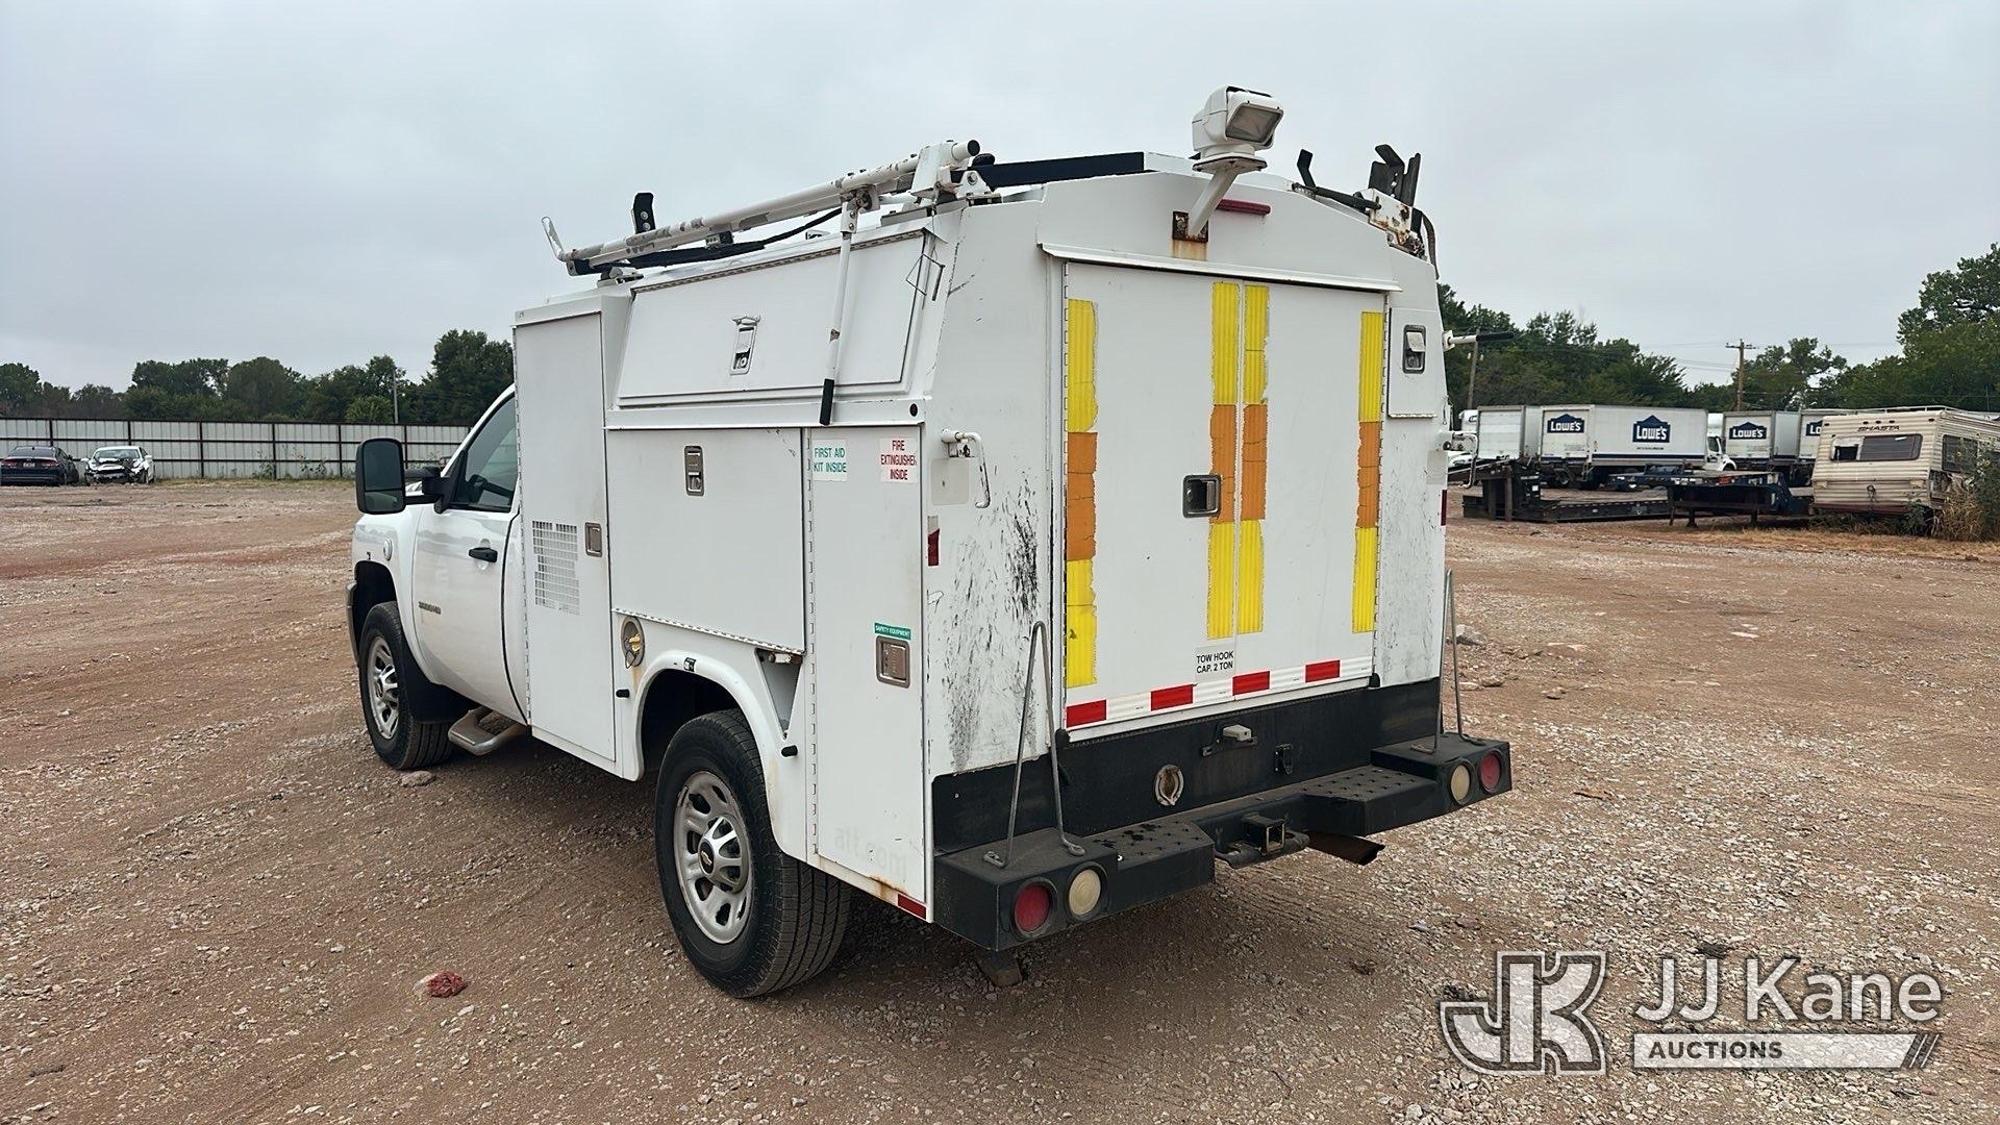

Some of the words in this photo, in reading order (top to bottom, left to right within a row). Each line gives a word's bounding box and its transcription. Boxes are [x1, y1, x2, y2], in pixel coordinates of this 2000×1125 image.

[1550, 421, 1582, 431] LOWE'S
[1636, 425, 1667, 440] LOWE'S
[1732, 428, 1764, 438] LOWE'S
[892, 440, 905, 451] FIRE
[814, 447, 832, 458] FIRST
[834, 447, 845, 458] AID
[880, 454, 918, 466] EXTINGUISHER
[813, 462, 823, 472] KIT
[825, 462, 847, 473] INSIDE
[890, 469, 908, 480] INSIDE
[1196, 654, 1212, 663] TOW
[1213, 650, 1234, 661] HOOK
[1196, 664, 1212, 673] CAP.
[1213, 663, 1218, 672] 2
[1219, 661, 1233, 670] TON
